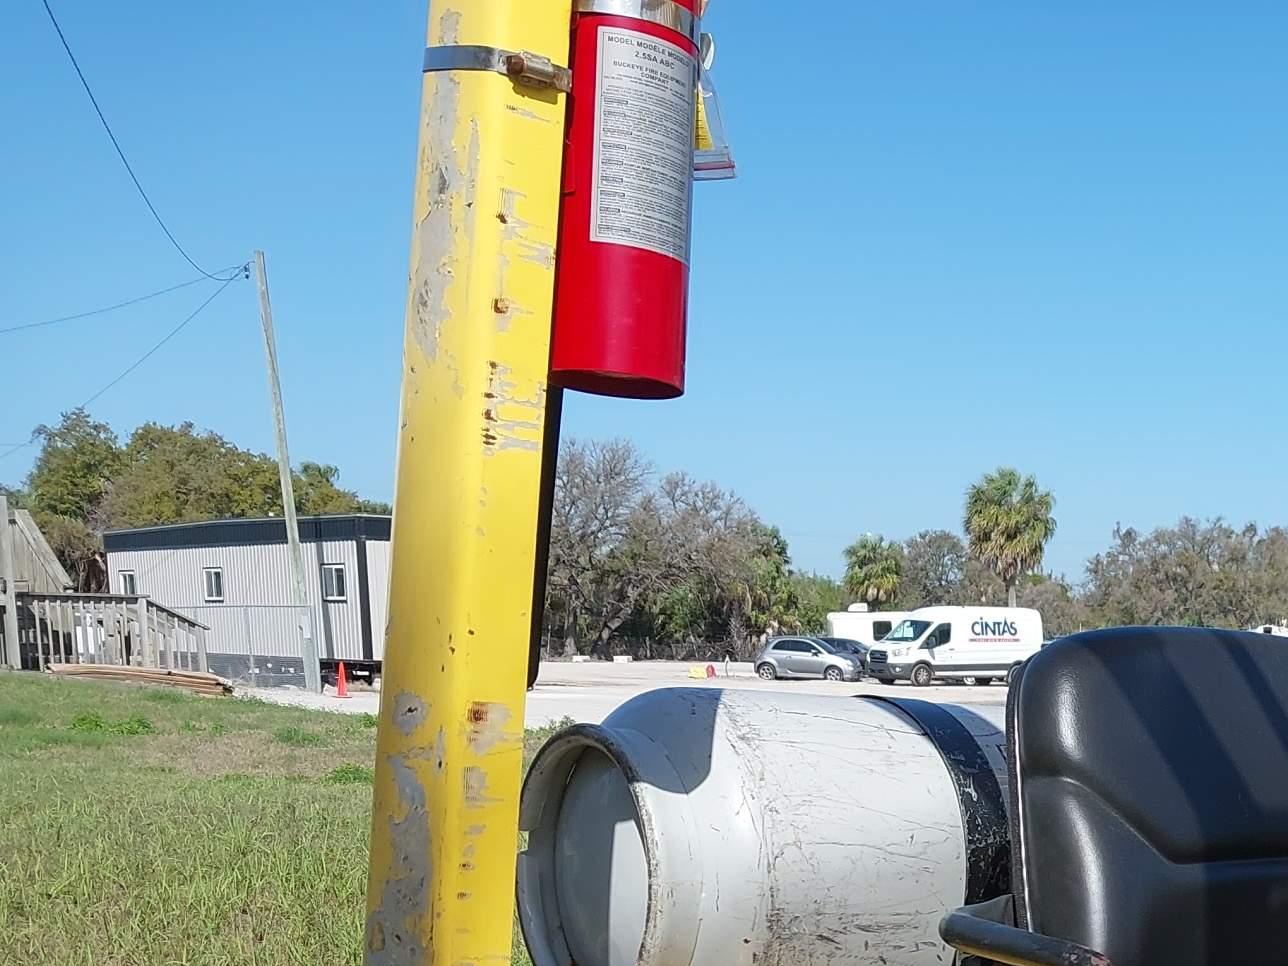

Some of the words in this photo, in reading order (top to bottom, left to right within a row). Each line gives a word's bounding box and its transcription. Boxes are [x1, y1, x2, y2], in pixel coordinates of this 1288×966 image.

[607, 35, 634, 46] MODEL
[613, 60, 644, 72] BUCKEYE
[645, 67, 659, 76] FIRE
[659, 58, 675, 70] ABC
[971, 616, 1018, 636] CINTAS
